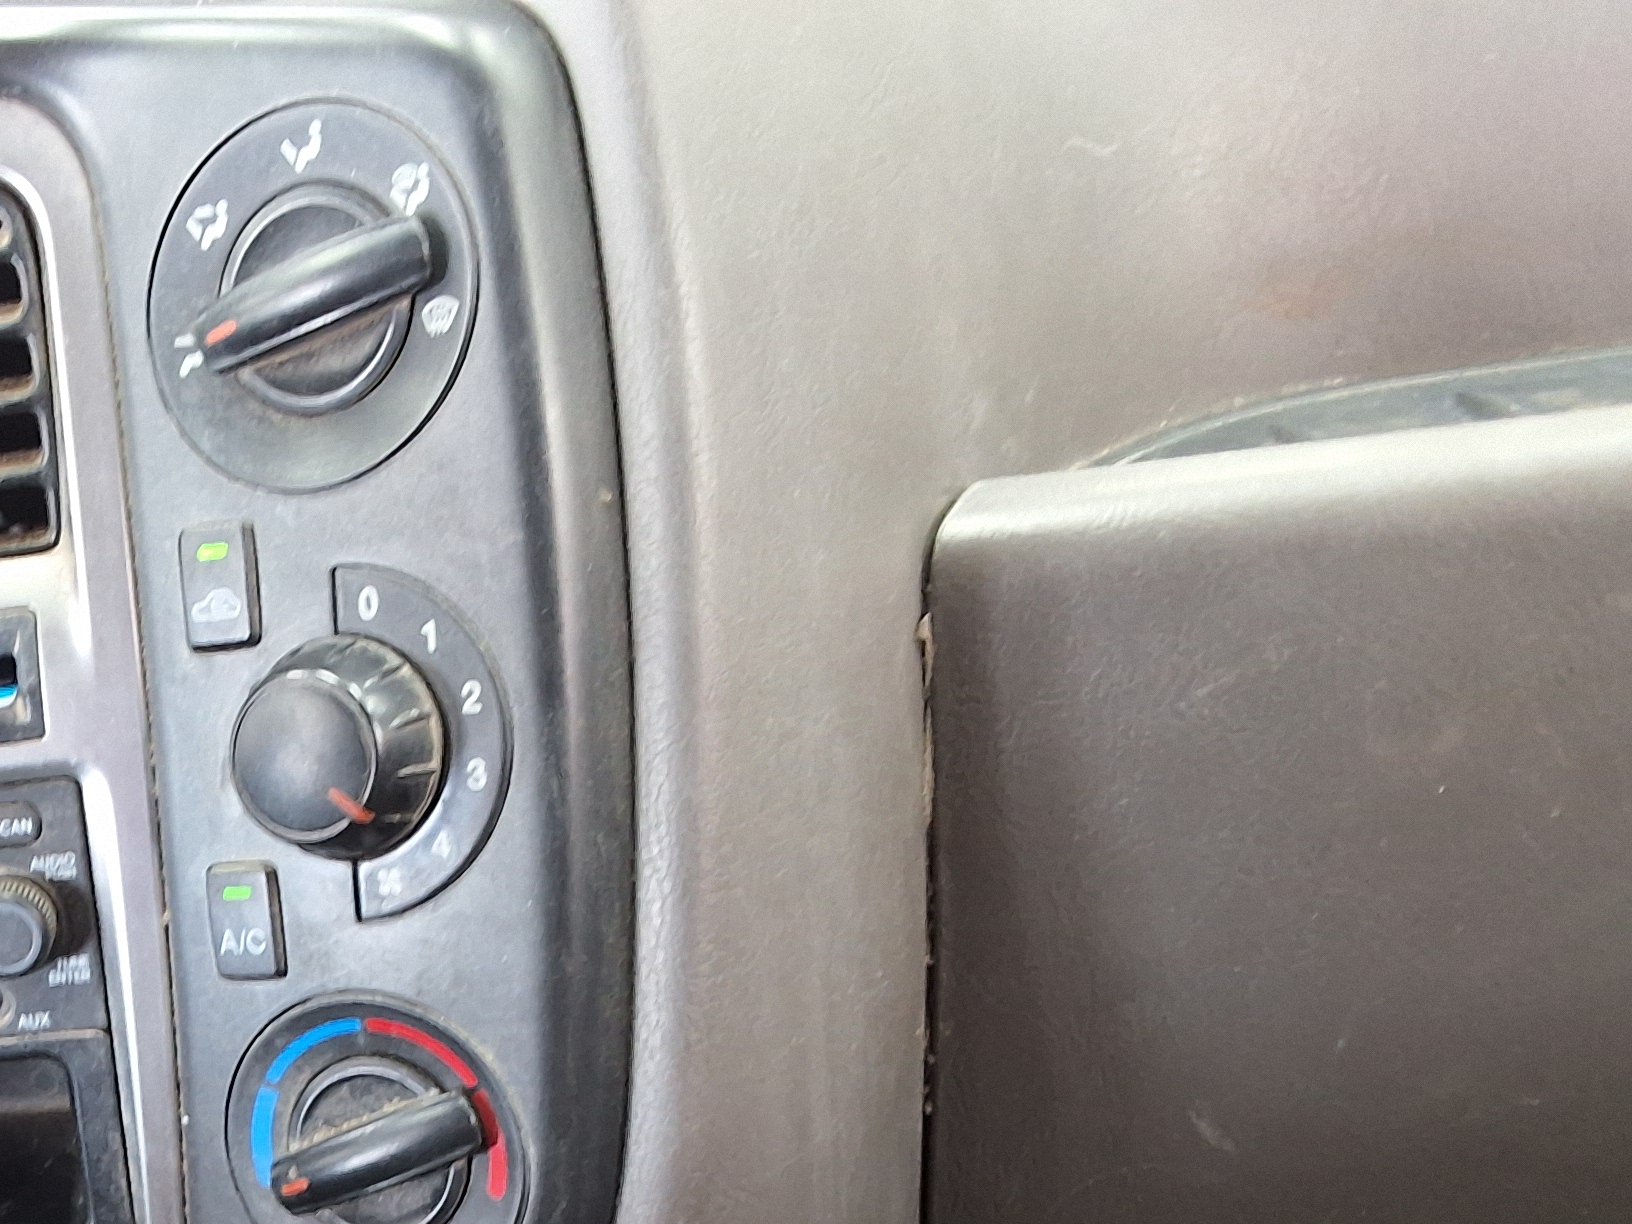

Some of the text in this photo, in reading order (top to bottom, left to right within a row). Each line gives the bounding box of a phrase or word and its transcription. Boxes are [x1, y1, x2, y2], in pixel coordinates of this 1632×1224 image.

[357, 585, 379, 620] 0
[420, 618, 438, 654] 1
[460, 678, 483, 716] 2
[465, 756, 488, 792] 3
[431, 829, 452, 859] 4
[220, 926, 267, 957] A/C
[18, 1010, 51, 1031] AUX
